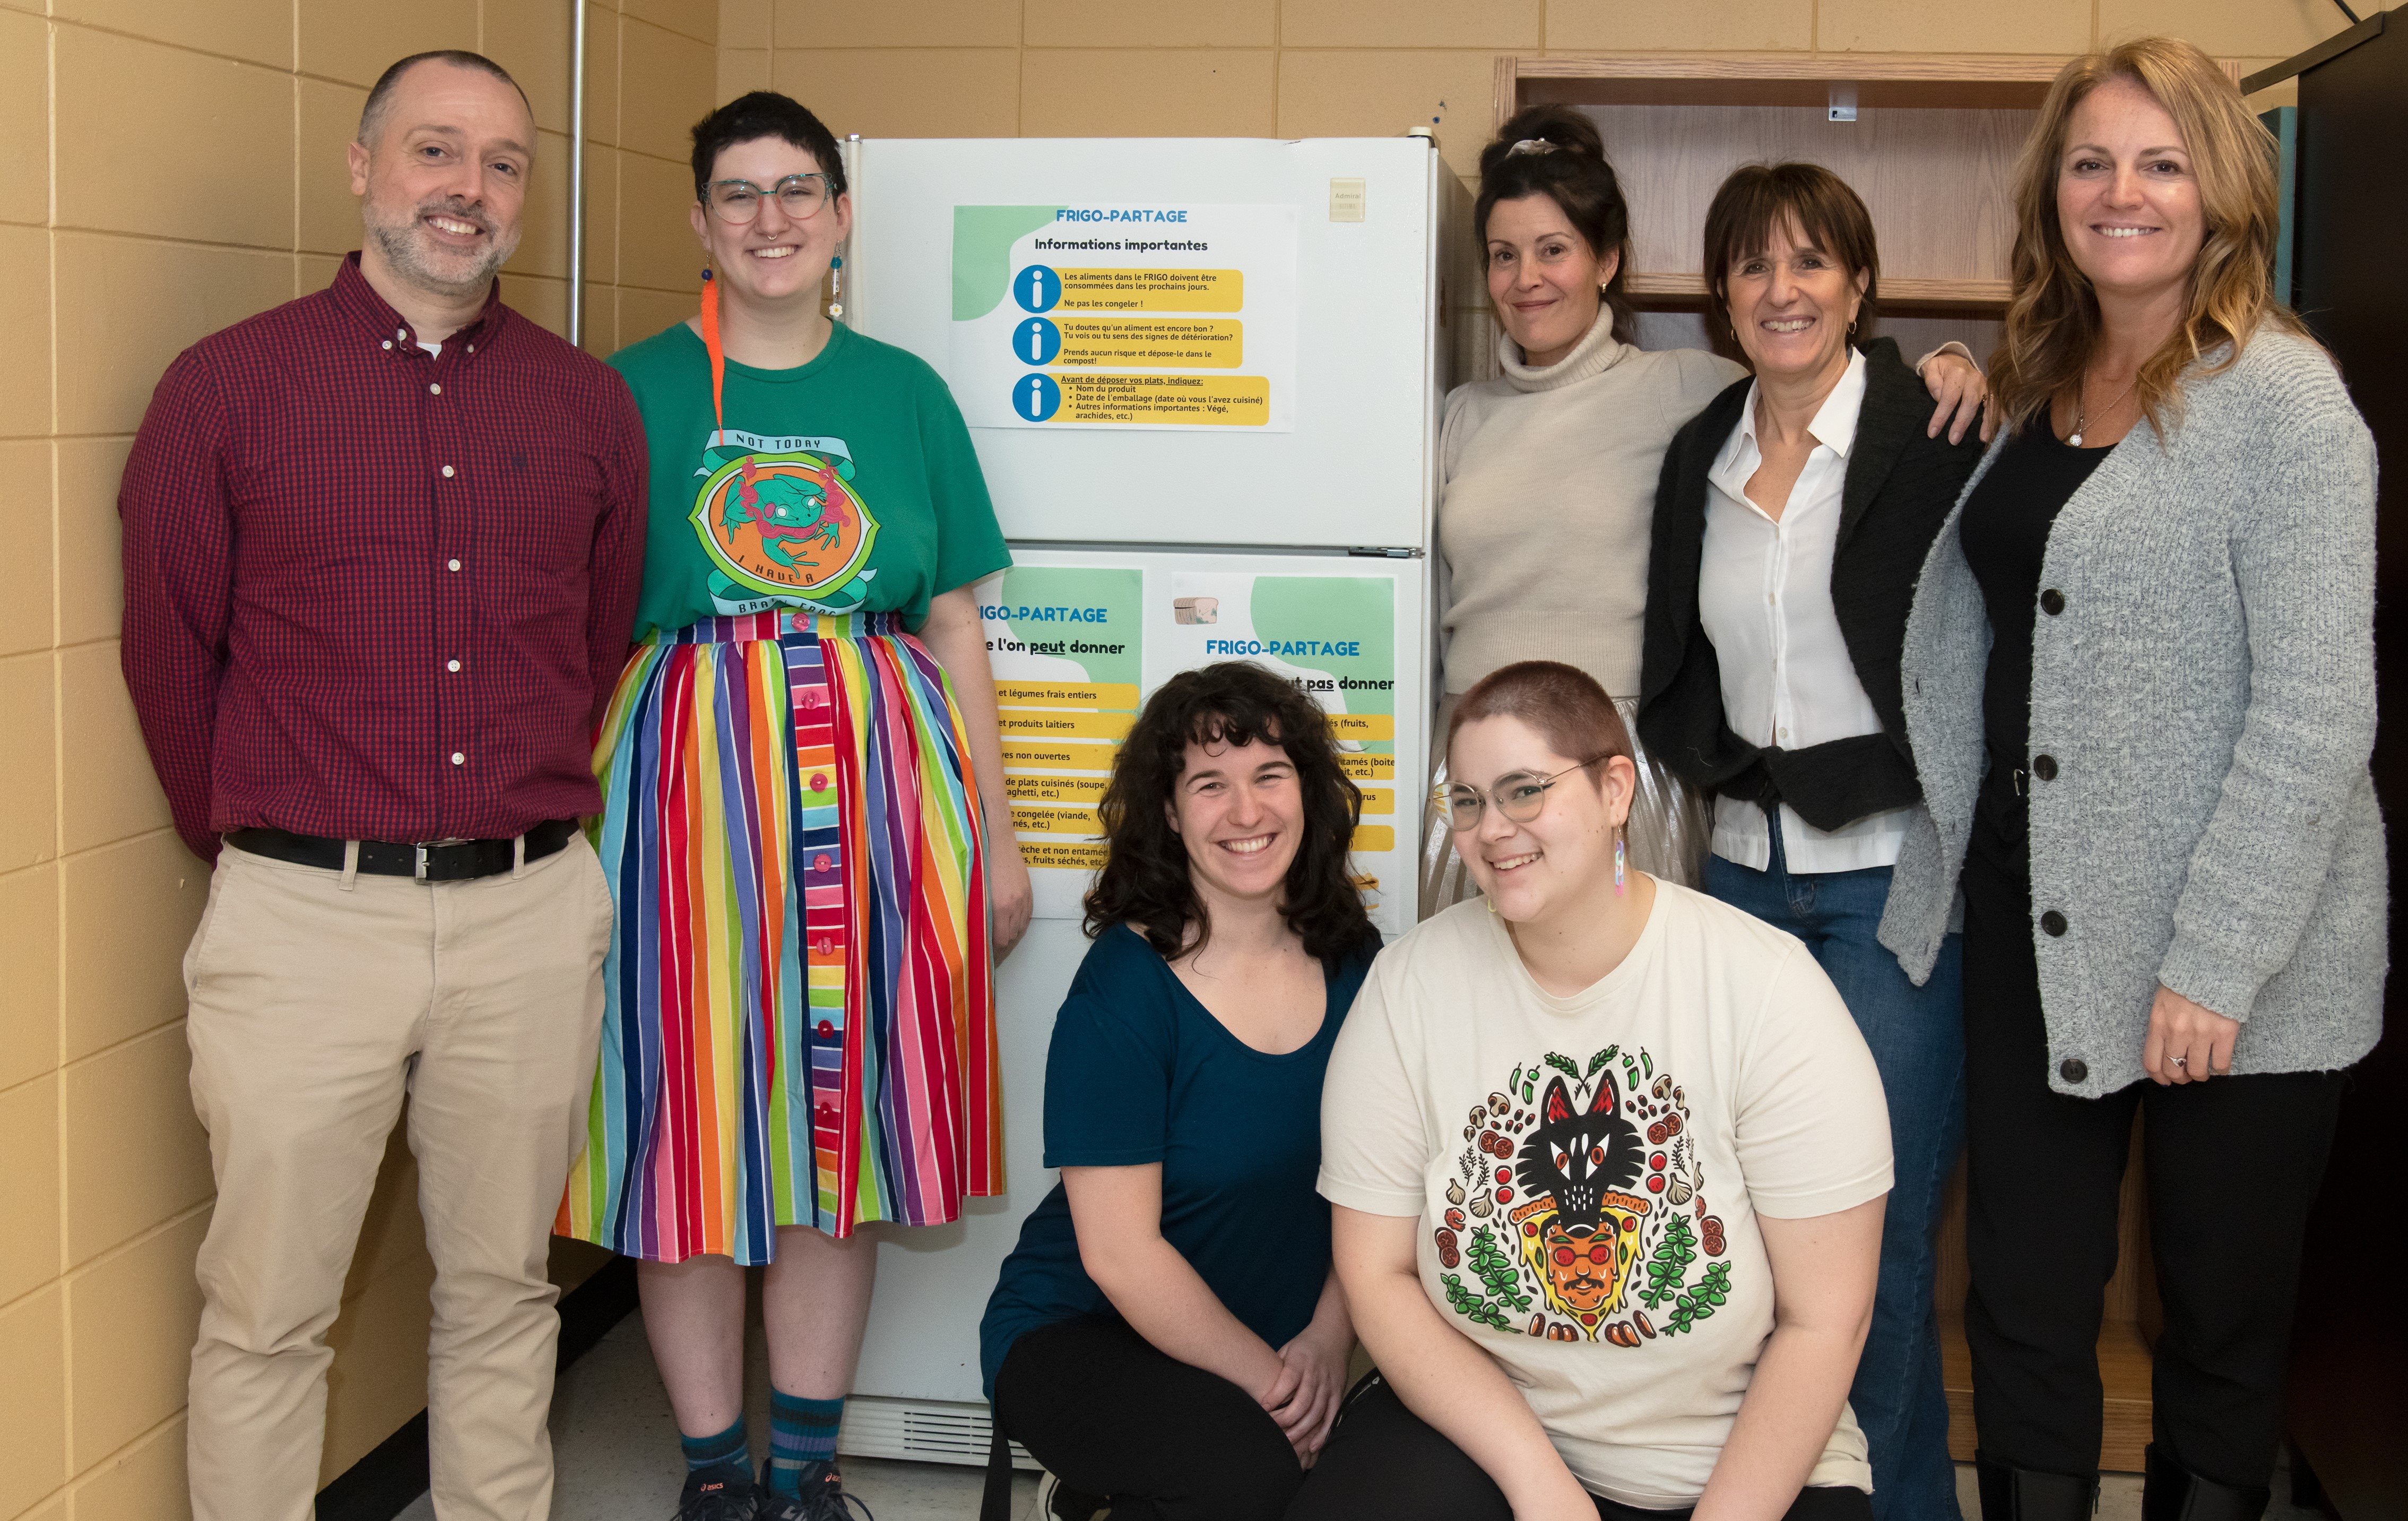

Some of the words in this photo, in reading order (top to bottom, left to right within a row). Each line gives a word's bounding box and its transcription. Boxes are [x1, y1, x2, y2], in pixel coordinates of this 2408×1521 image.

[1056, 210, 1187, 222] FRIGO-PARTAGE
[1035, 238, 1121, 249] Informations
[1125, 239, 1208, 253] importantes
[1168, 377, 1203, 386] indiquez:
[1108, 394, 1152, 403] l'emballage
[1233, 396, 1262, 405] cuisiné)
[1207, 405, 1228, 413] Végé,
[737, 433, 764, 448] NOT
[775, 439, 820, 449] TODAY
[805, 574, 813, 583] A
[977, 606, 1107, 623] IGO-PARTAGE
[999, 638, 1025, 651] l'on
[1030, 640, 1066, 655] peut
[1070, 640, 1125, 654] donner
[1207, 640, 1359, 656] FRIGO-PARTAGE
[1307, 679, 1334, 692] pas
[1338, 676, 1394, 689] donner
[1010, 689, 1044, 698] légumes
[1009, 720, 1043, 728] produits
[1341, 719, 1368, 729] (fruits,
[1371, 758, 1394, 767] (boite
[1355, 768, 1373, 777] etc.)
[1018, 779, 1038, 788] plats
[1007, 789, 1038, 797] aghetti,
[1042, 790, 1059, 799] etc.)
[1017, 811, 1054, 819] congelée
[1058, 811, 1090, 821] (viande,
[1032, 821, 1050, 830] etc.)
[1033, 855, 1054, 864] fruits
[1058, 857, 1087, 866] séchés,
